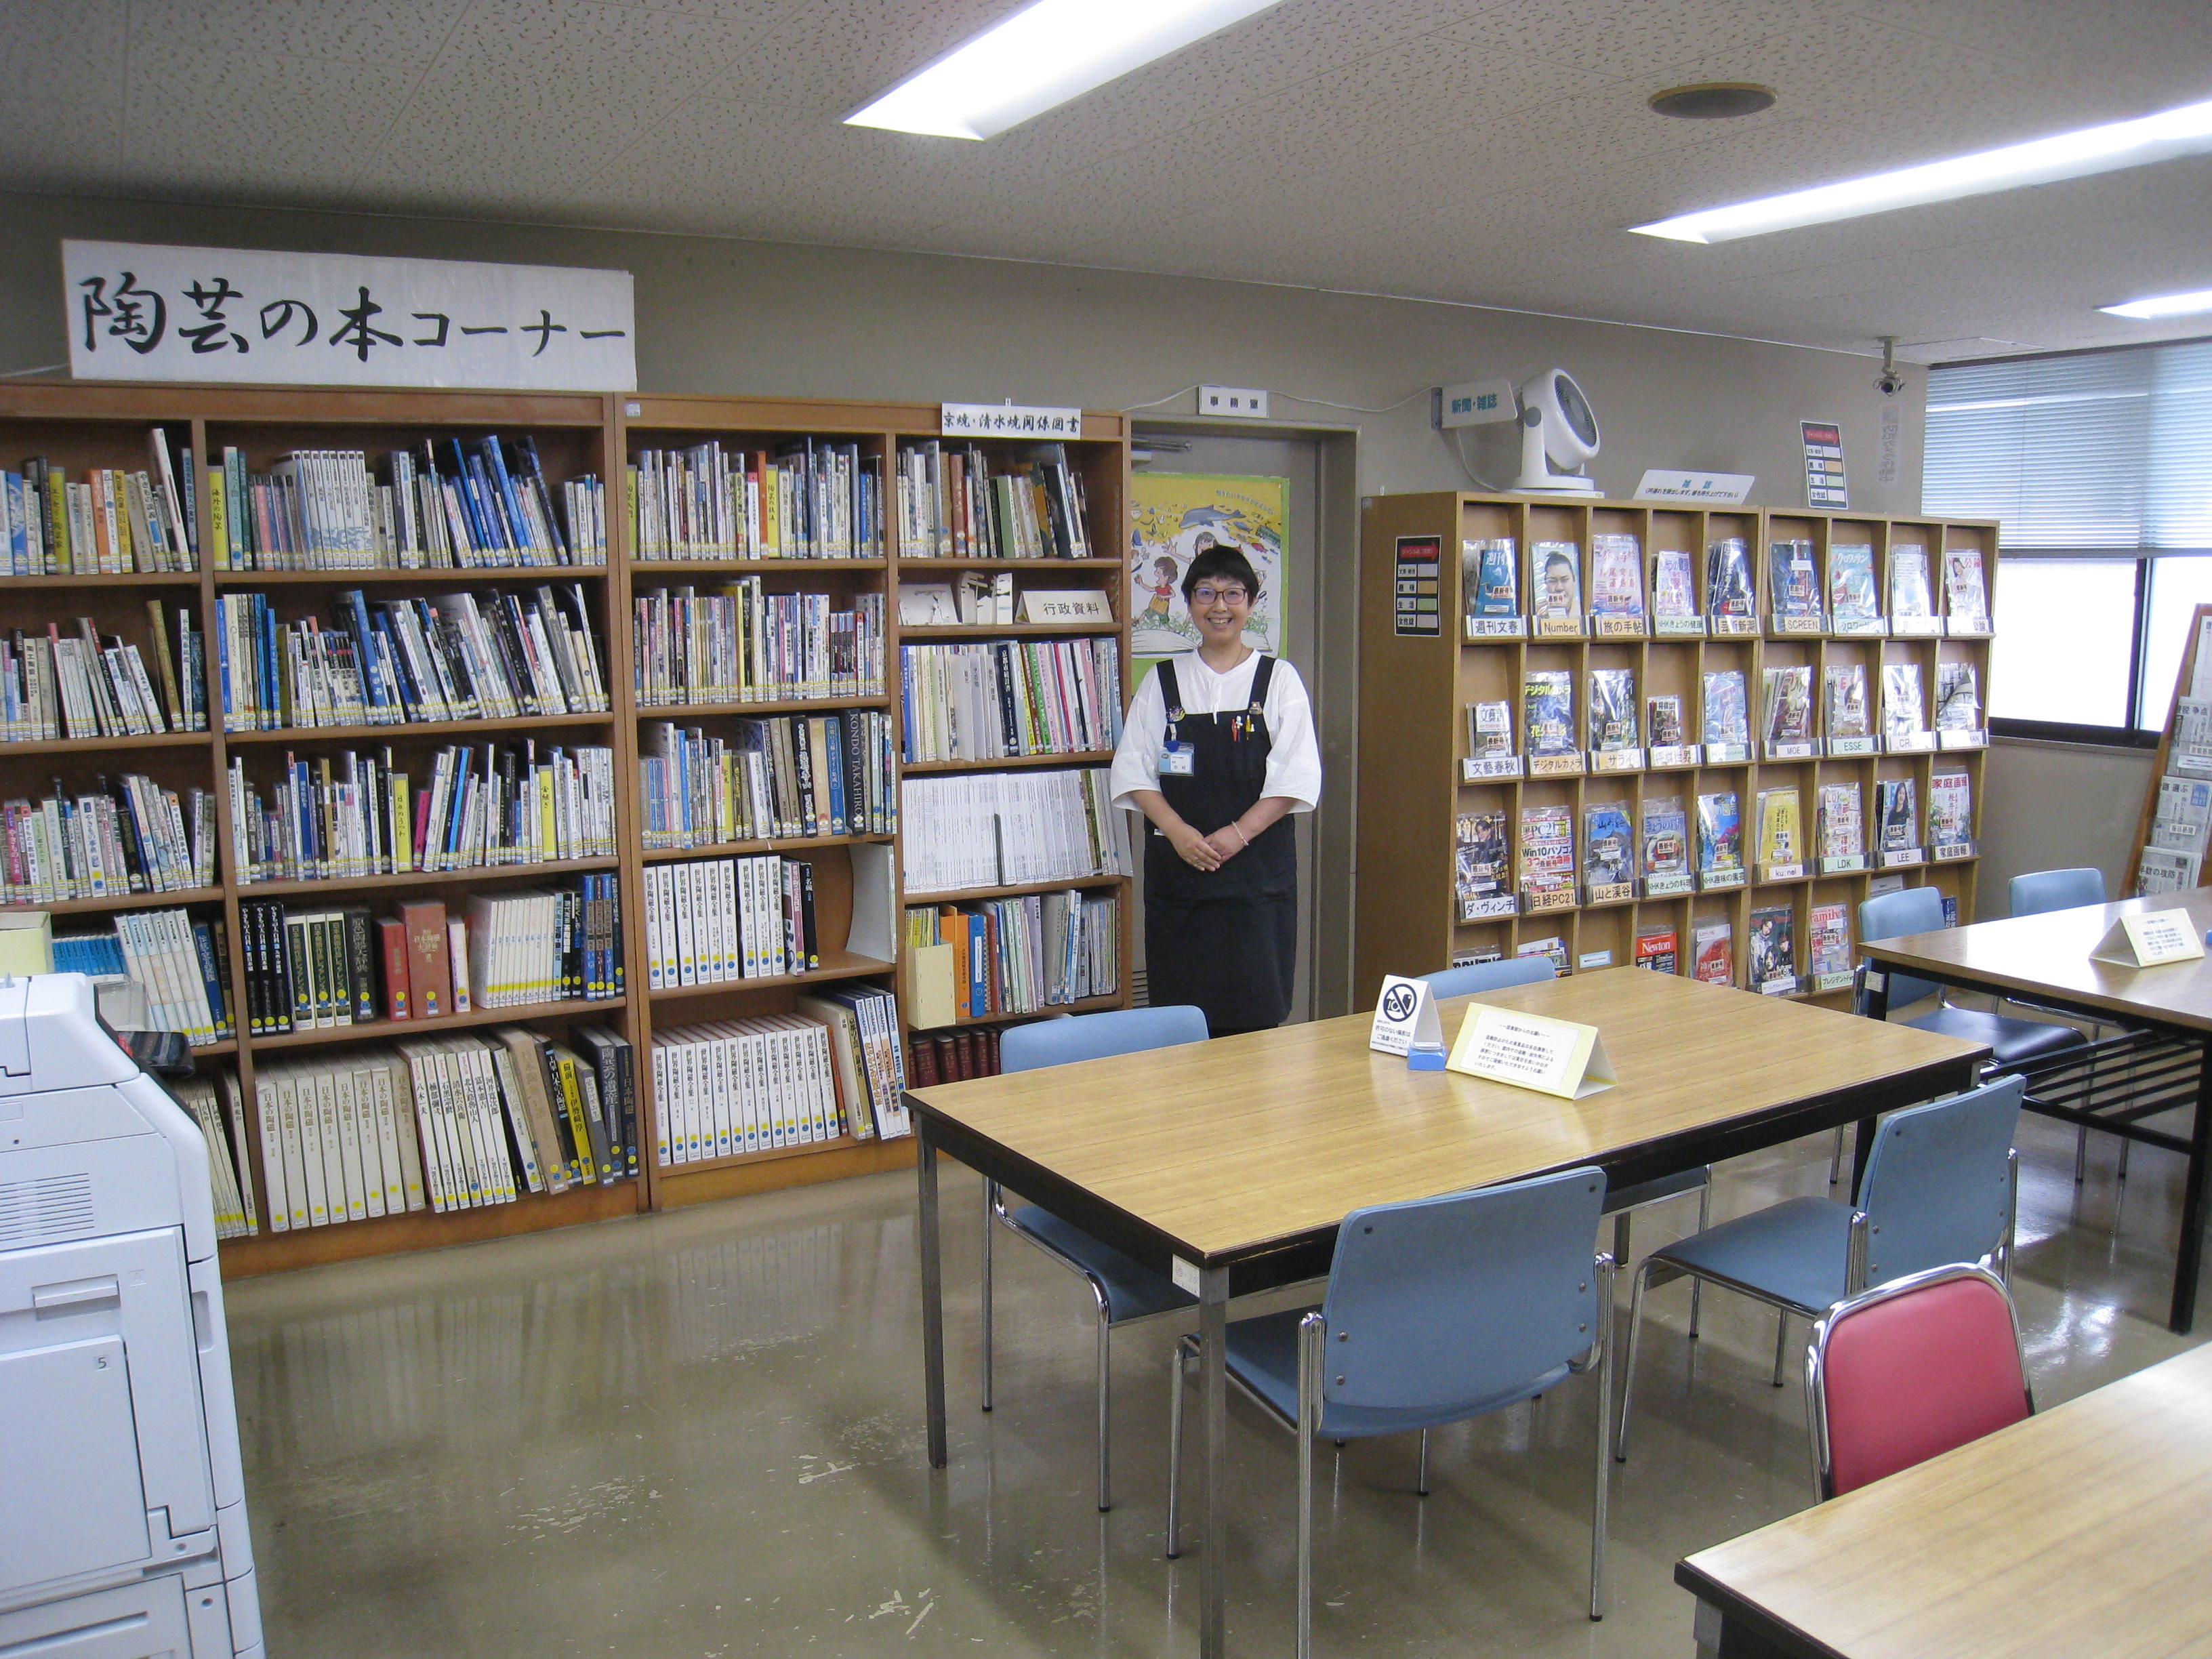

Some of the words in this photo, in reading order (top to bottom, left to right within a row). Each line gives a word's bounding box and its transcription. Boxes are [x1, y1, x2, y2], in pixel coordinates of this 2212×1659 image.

[79, 271, 627, 362] 陶芸の本コーナー
[1451, 393, 1498, 415] 新聞・雑誌
[1043, 602, 1099, 615] 行政資料
[1398, 617, 1414, 626] 女性誌
[1475, 620, 1518, 634] 週刊文春
[1544, 621, 1578, 632] Number
[1603, 621, 1642, 633] 旅の手帖
[1788, 619, 1818, 630] SCREEN
[1525, 684, 1571, 696] デジタルカメラ
[850, 713, 859, 756] KONDO
[1845, 741, 1862, 751] ESSE
[1533, 759, 1582, 771] デジタルカメラ
[1607, 754, 1633, 766] サライ
[1473, 761, 1515, 775] 文藝春秋
[852, 760, 863, 818] TAKAHIRO
[397, 796, 405, 836] 日々のうつわ
[1898, 853, 1910, 862] LEE
[1940, 846, 1967, 858] 家庭画報
[1837, 859, 1851, 869] LDK
[1533, 893, 1574, 907] 日経PC21
[1466, 899, 1515, 915] ダ・ヴィンチ
[1641, 941, 1671, 954] Newton
[416, 1084, 428, 1115] 八木一夫
[464, 1078, 478, 1124] 北大路魯山人
[98, 1357, 107, 1368] 5
